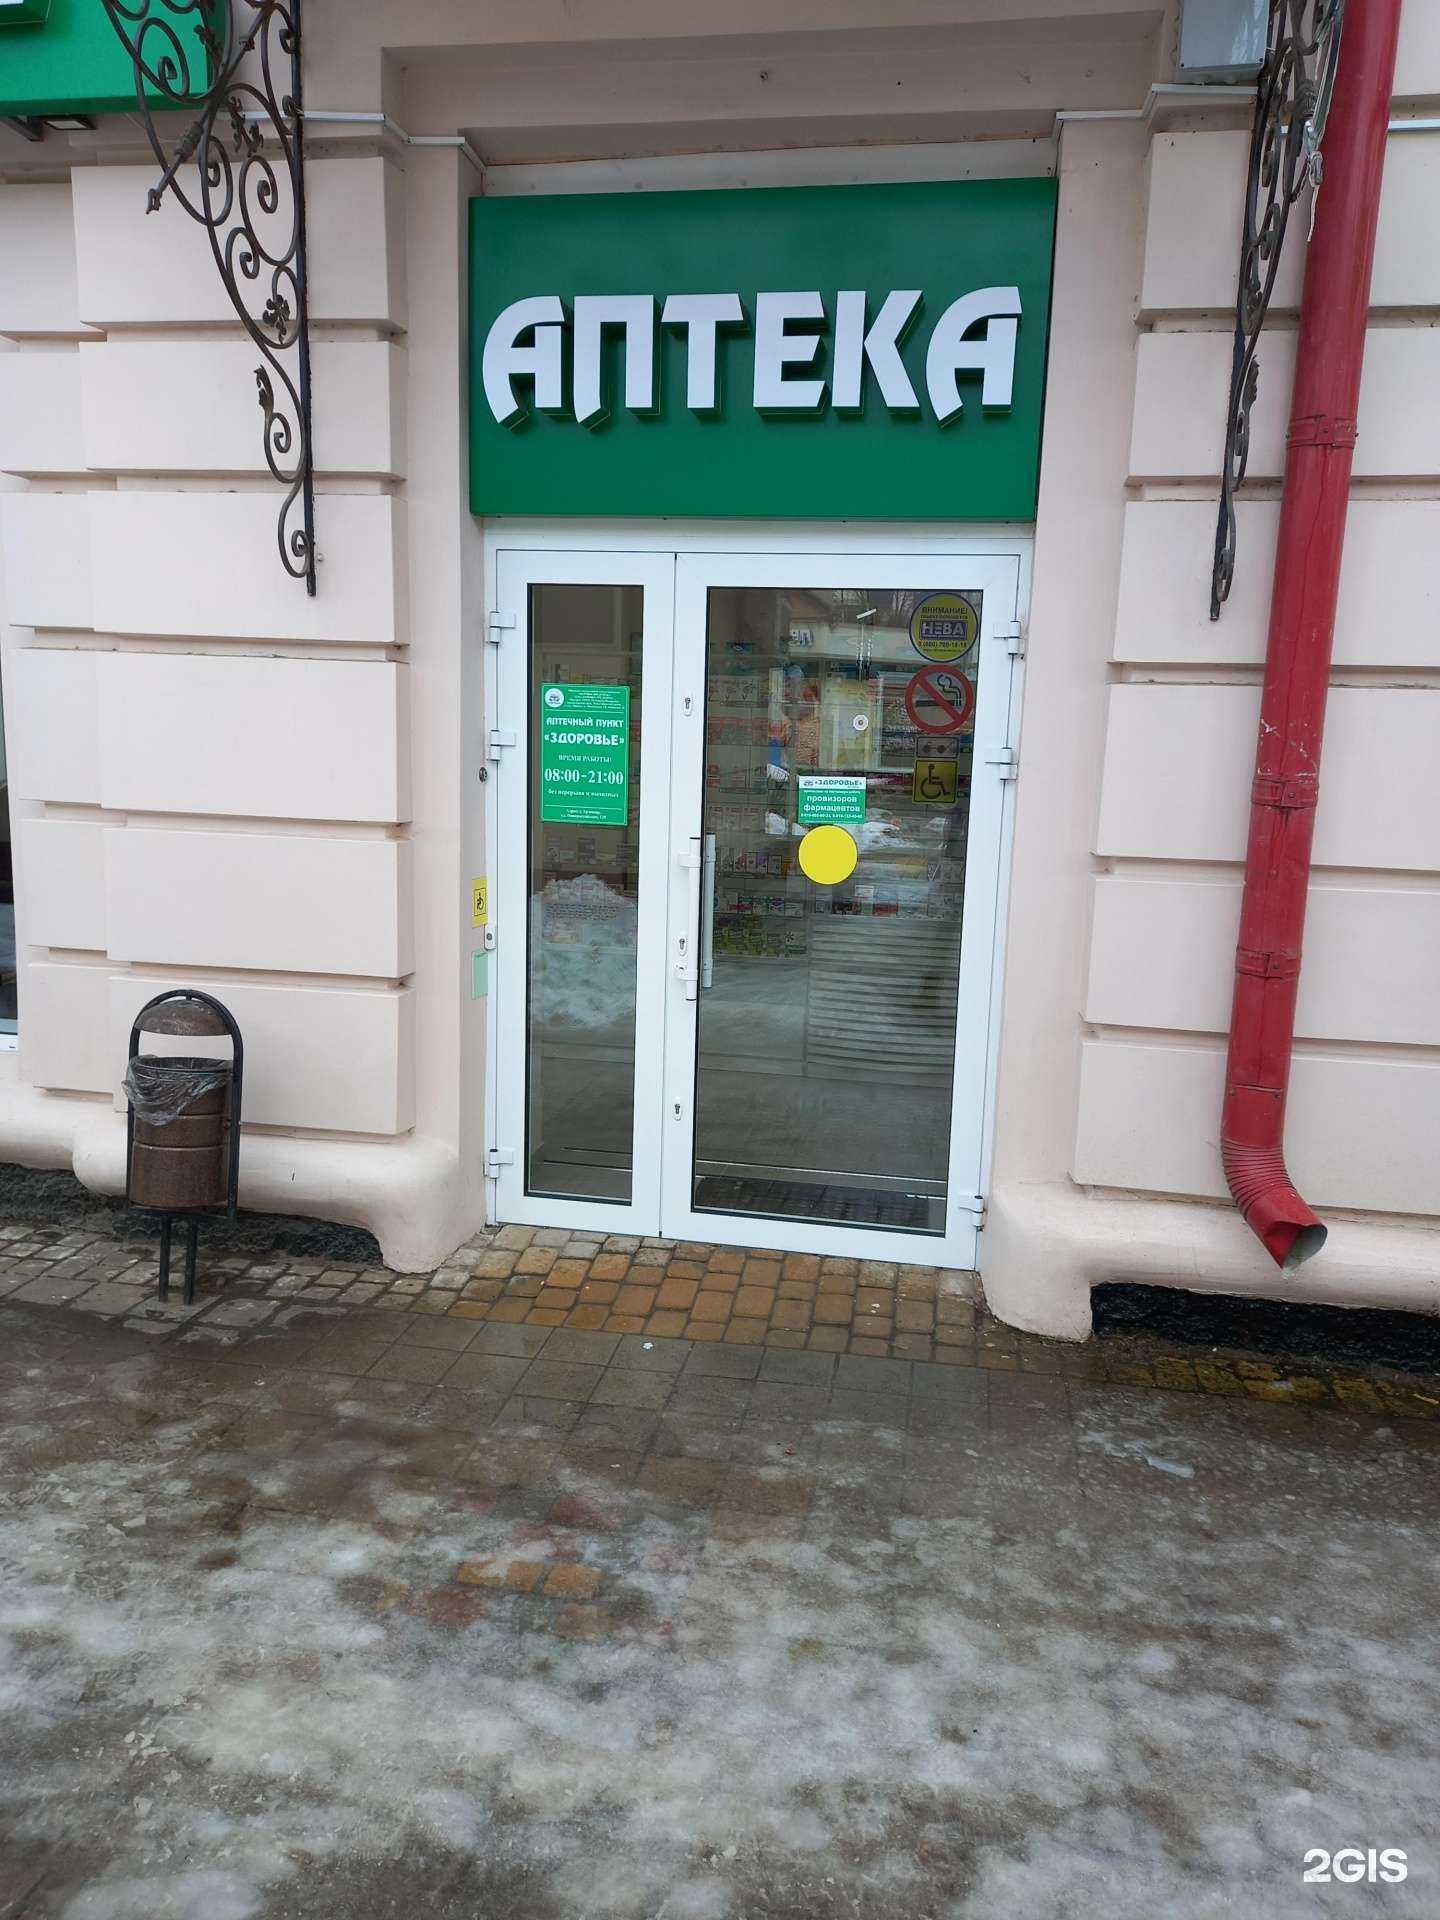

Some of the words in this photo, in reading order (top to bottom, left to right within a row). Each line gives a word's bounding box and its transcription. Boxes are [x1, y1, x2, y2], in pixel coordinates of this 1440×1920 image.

[482, 286, 1023, 424] АПТЕКА
[922, 622, 964, 635] НЕВА
[546, 717, 593, 727] АПТЕЧНЫЙ
[596, 719, 624, 728] ПУНКТ
[544, 732, 625, 746] «ЗДОРОВЬЕ»
[807, 795, 857, 803] провизоров
[803, 803, 860, 812] фармацевтов
